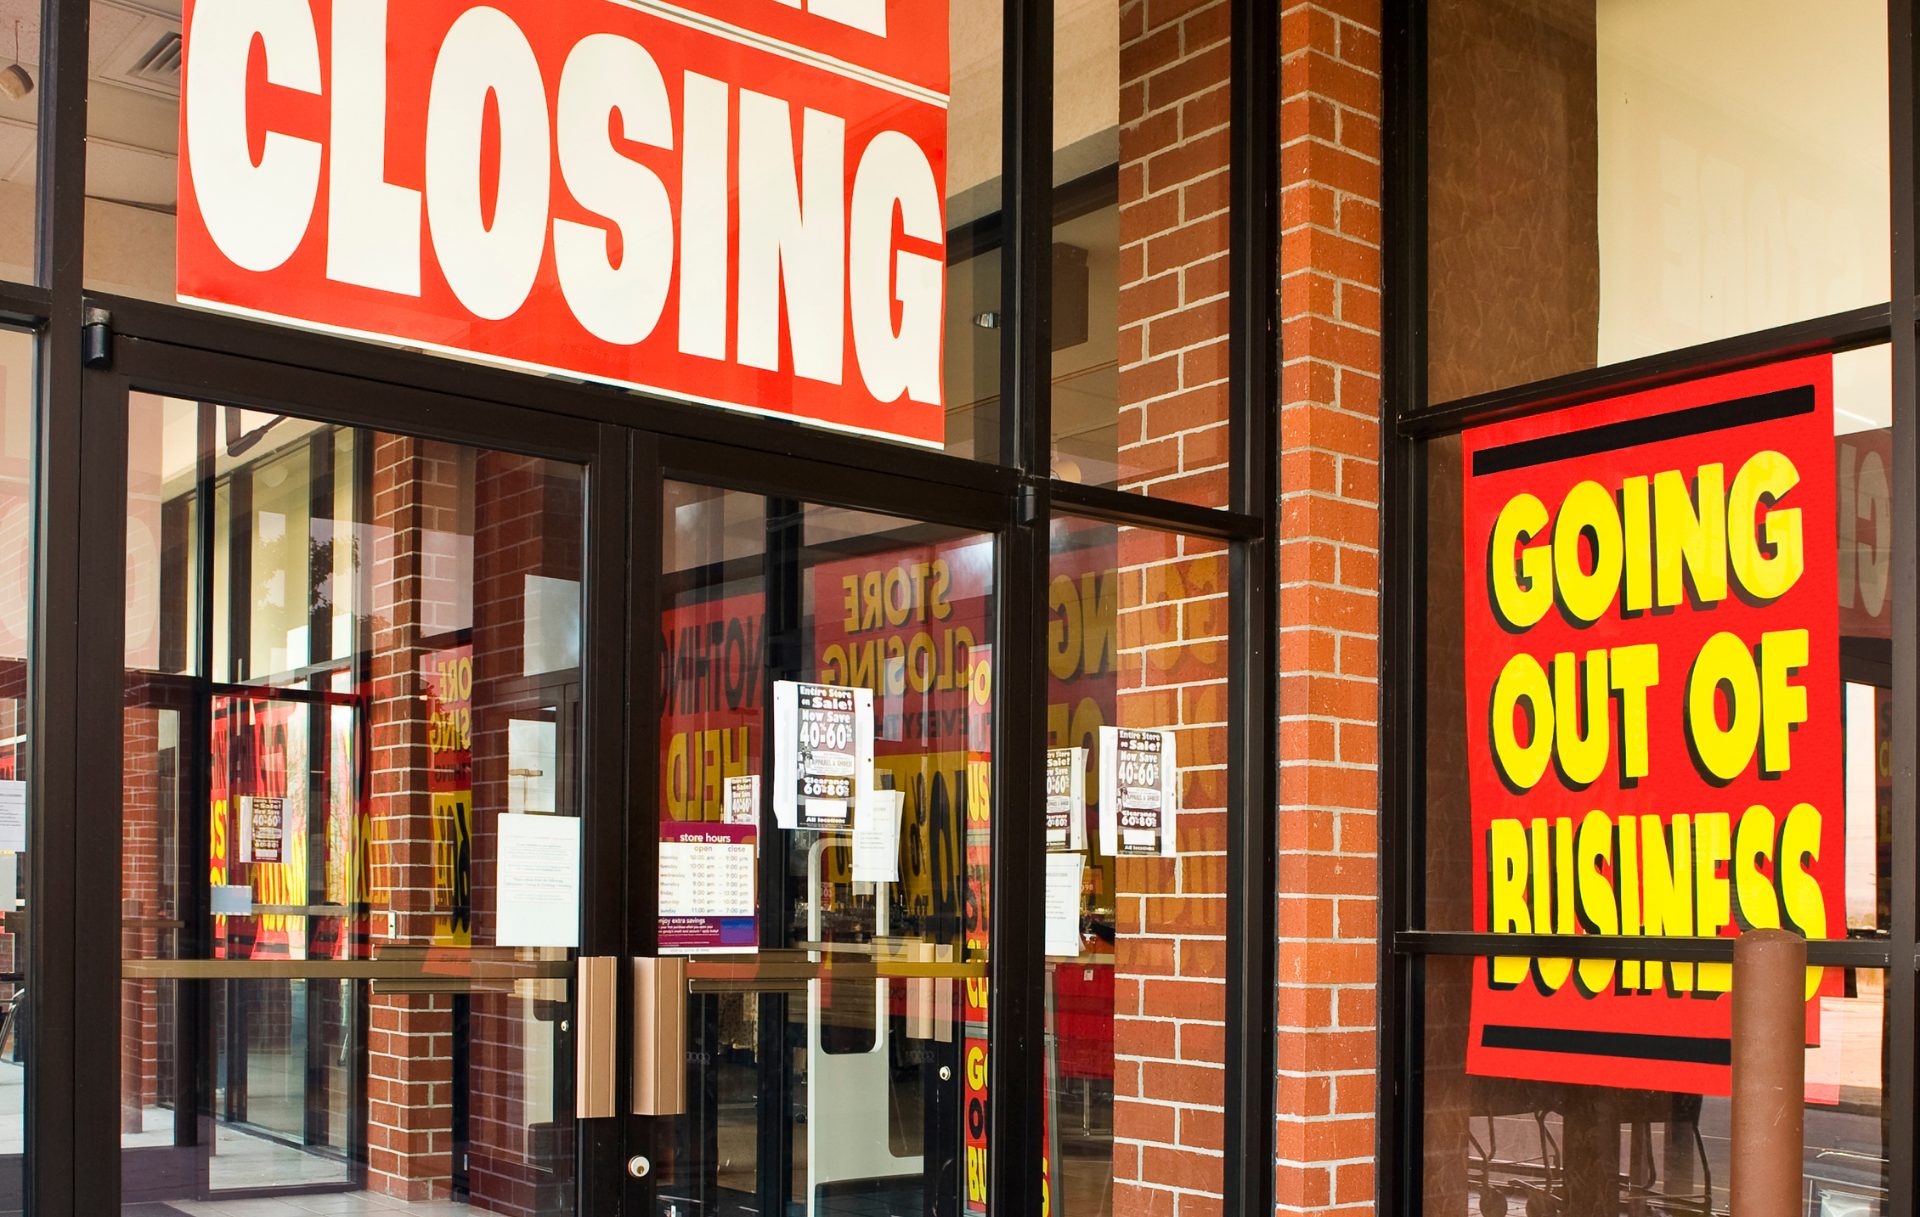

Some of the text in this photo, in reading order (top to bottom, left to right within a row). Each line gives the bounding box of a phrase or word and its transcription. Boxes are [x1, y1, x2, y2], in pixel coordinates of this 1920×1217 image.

[186, 0, 945, 405] CLOSING
[1490, 450, 1804, 632] GOING
[800, 686, 852, 699] Entire Store
[812, 697, 853, 710] Sale!
[802, 709, 851, 723] Now Save
[1491, 643, 1659, 793] OUT
[1685, 628, 1810, 783] OF
[1119, 731, 1160, 741] Entire Store
[1129, 740, 1160, 752] Sale!
[1047, 757, 1070, 767] Sale!
[1120, 751, 1158, 764] Now Save
[1055, 768, 1068, 776] Save
[680, 832, 731, 843] store hours
[728, 845, 746, 853] close
[1488, 802, 1826, 1004] BUSINESS
